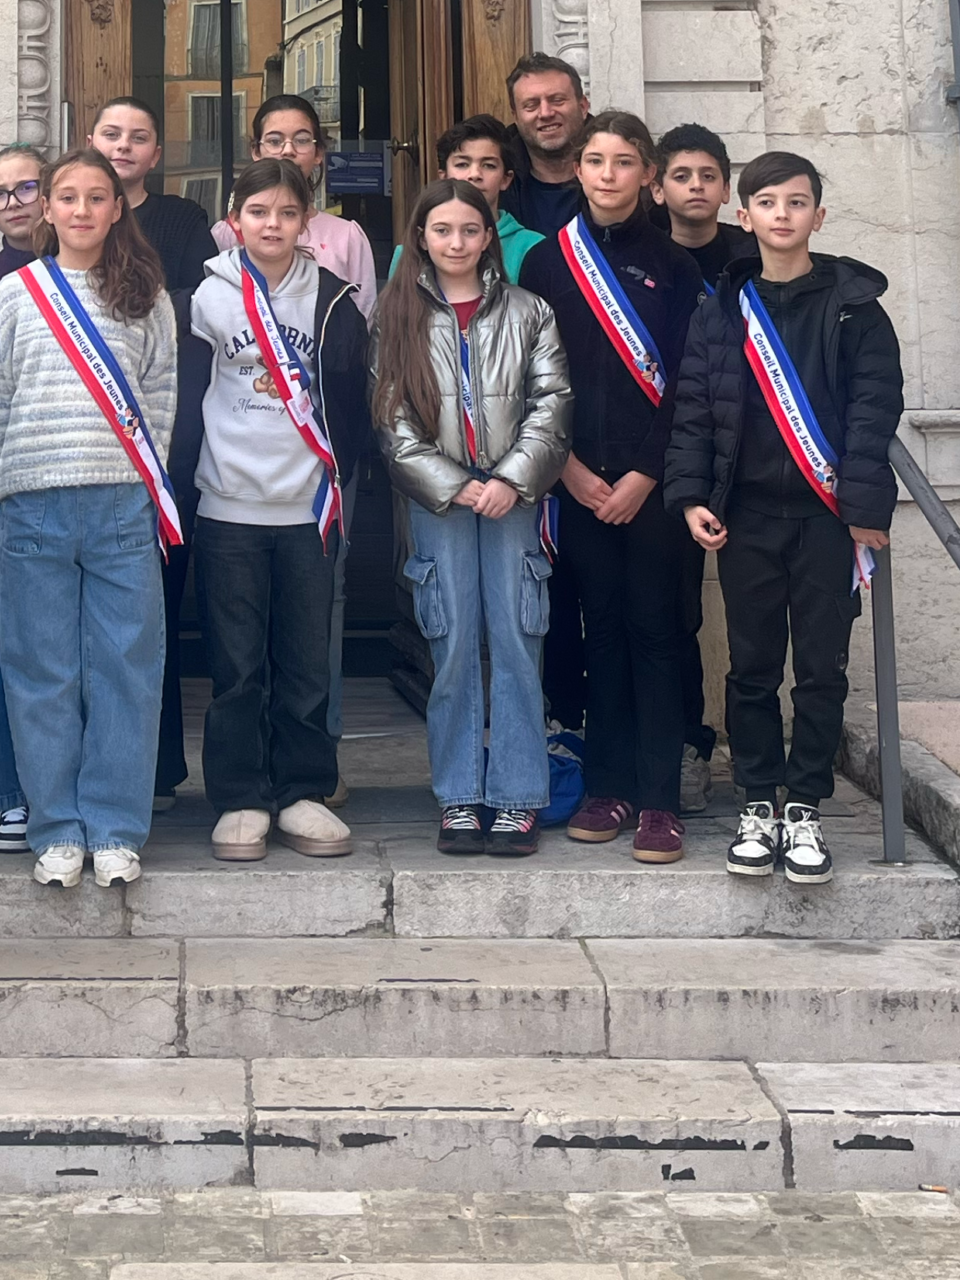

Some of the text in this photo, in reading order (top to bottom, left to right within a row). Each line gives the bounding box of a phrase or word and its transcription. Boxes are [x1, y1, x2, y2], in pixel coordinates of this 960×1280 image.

[50, 292, 124, 411] Conseil Municipal des Jeunes
[271, 334, 284, 360] Jeunes
[574, 240, 642, 357] Conseil Municipal des Jeunes
[753, 332, 822, 468] Conseil Municipal des Jeunes
